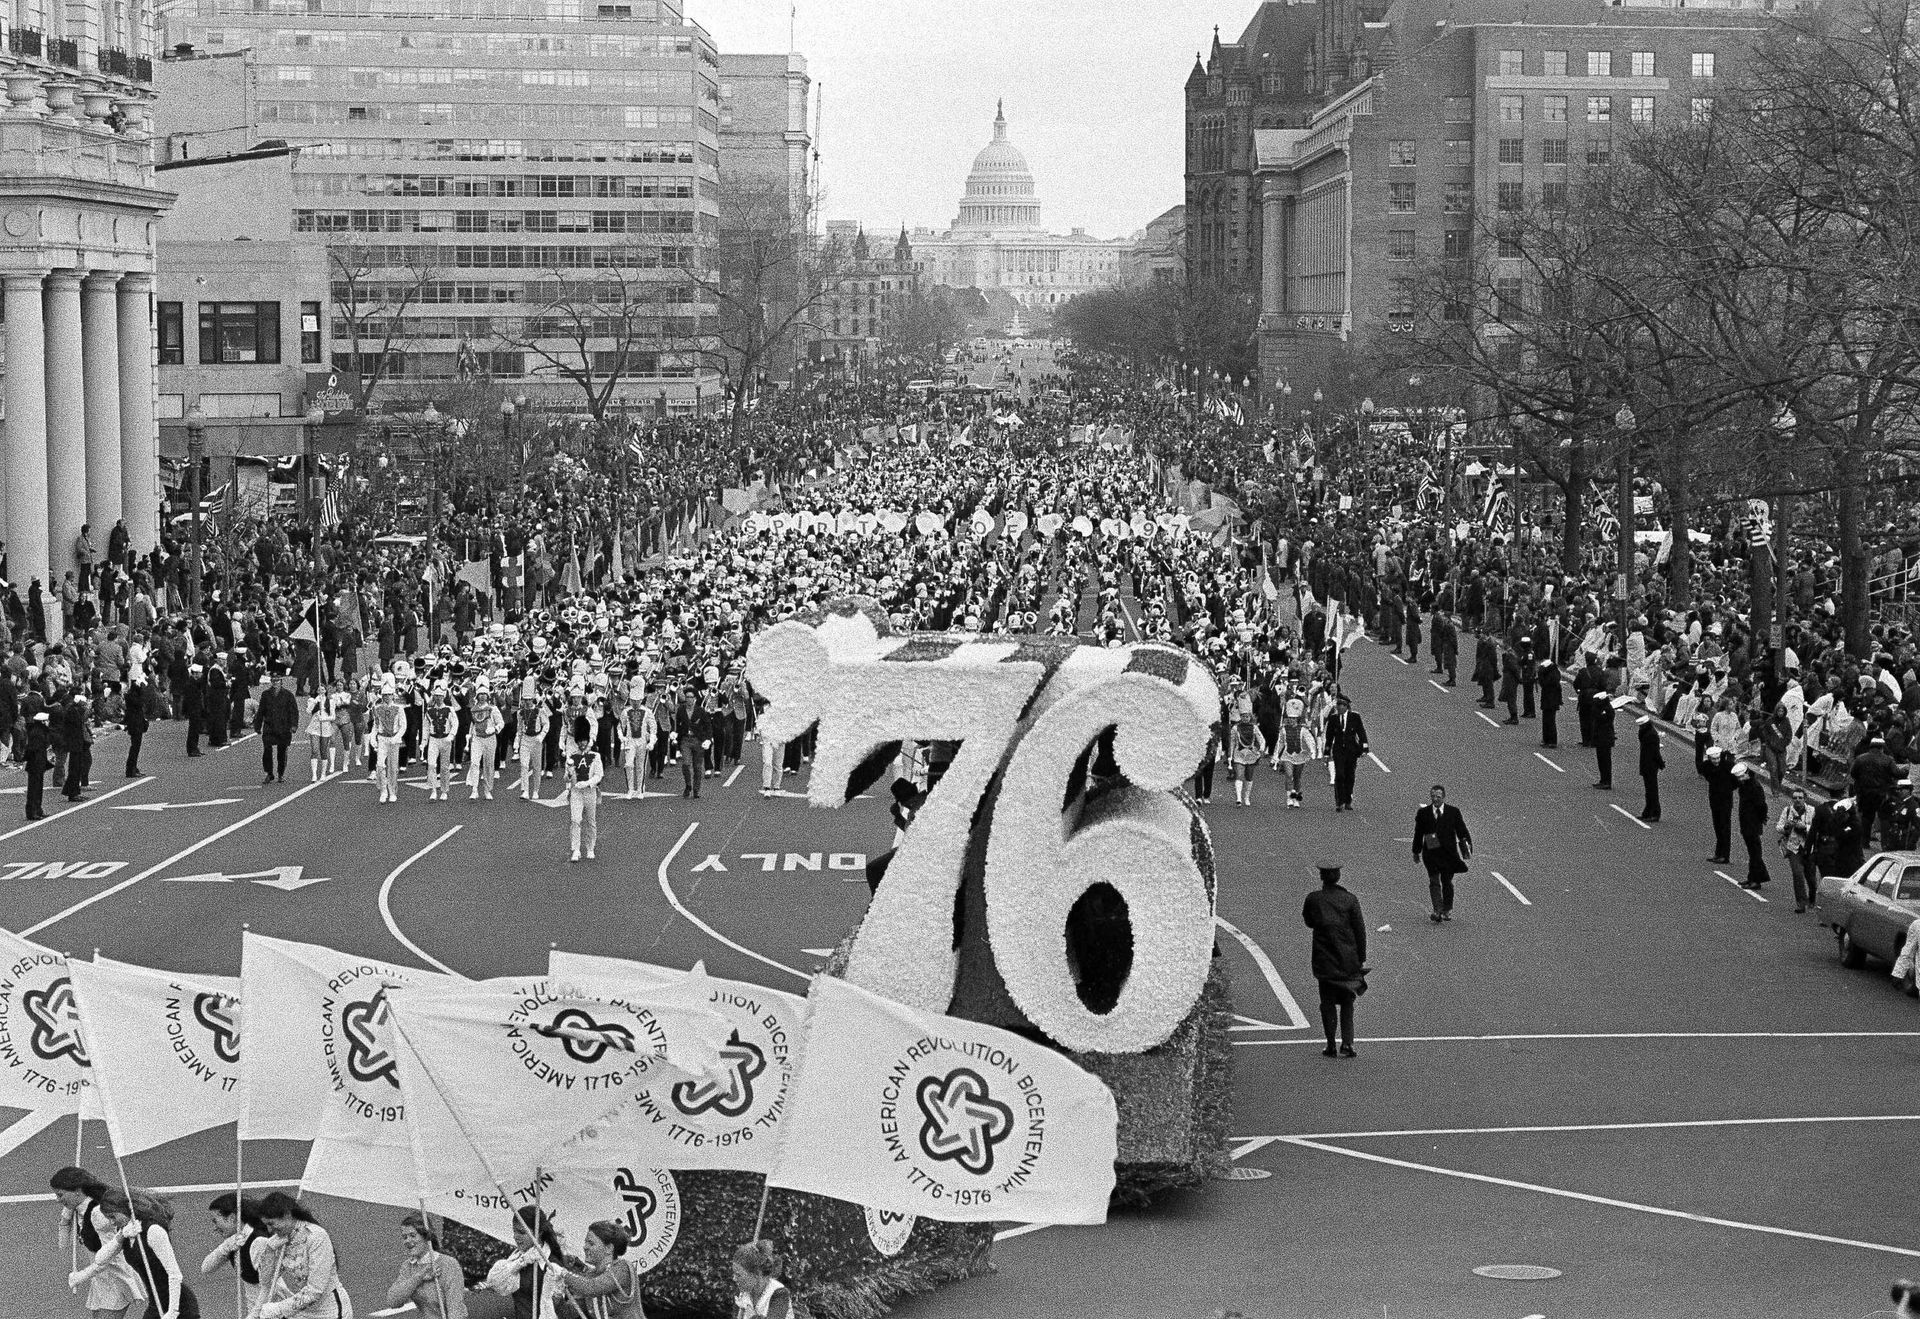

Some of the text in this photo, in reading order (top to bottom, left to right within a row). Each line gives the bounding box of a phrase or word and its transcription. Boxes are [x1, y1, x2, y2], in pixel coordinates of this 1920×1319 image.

[577, 757, 588, 769] A
[690, 852, 867, 872] ONLY
[0, 979, 24, 1068] AMERICAN
[166, 997, 217, 1082] AMERICAN
[322, 996, 345, 1092] AMERICAN
[506, 1012, 576, 1090] AMERICA
[667, 1123, 753, 1148] 1776-1976
[880, 1059, 911, 1162] AMERICAN
[906, 1036, 1020, 1075] REVOLUTION
[906, 1166, 992, 1206] 1776-1976
